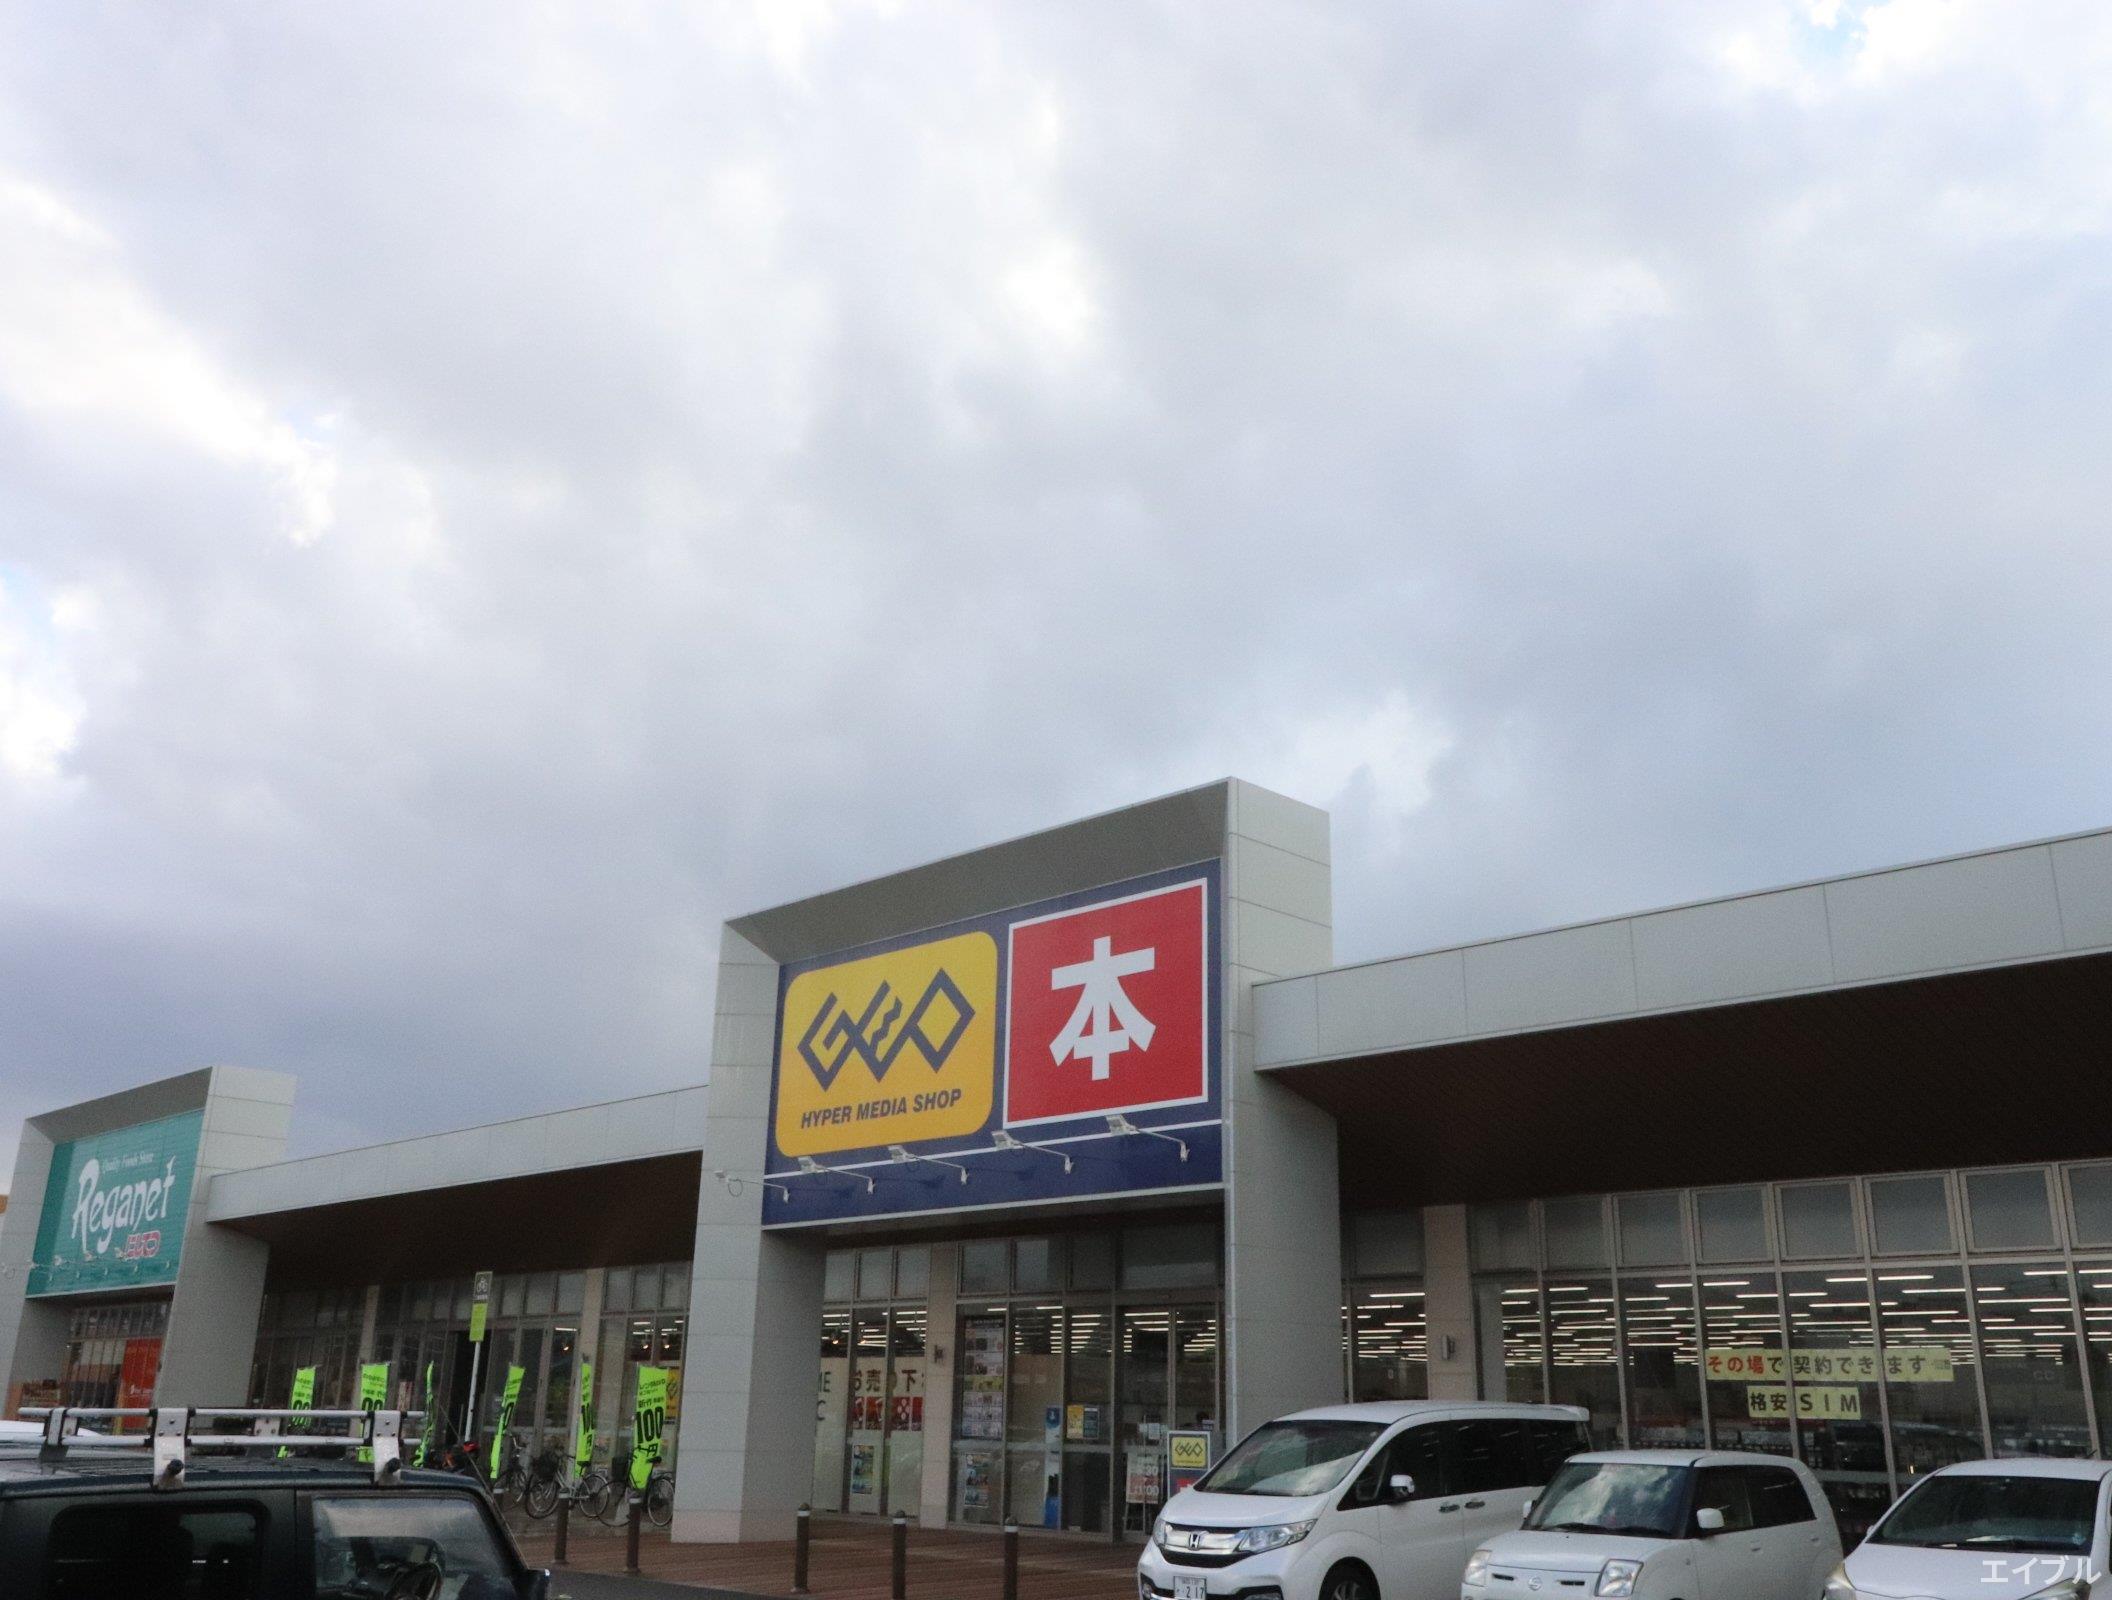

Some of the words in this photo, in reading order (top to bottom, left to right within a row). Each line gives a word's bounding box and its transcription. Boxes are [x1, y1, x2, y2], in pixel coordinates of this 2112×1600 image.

[798, 968, 976, 1092] GEO
[1049, 936, 1156, 1081] 本
[801, 1106, 851, 1129] HYPER
[856, 1097, 907, 1121] MEDIA
[913, 1088, 962, 1113] SHOP
[71, 1154, 176, 1254] Reganet
[636, 1406, 664, 1444] 100
